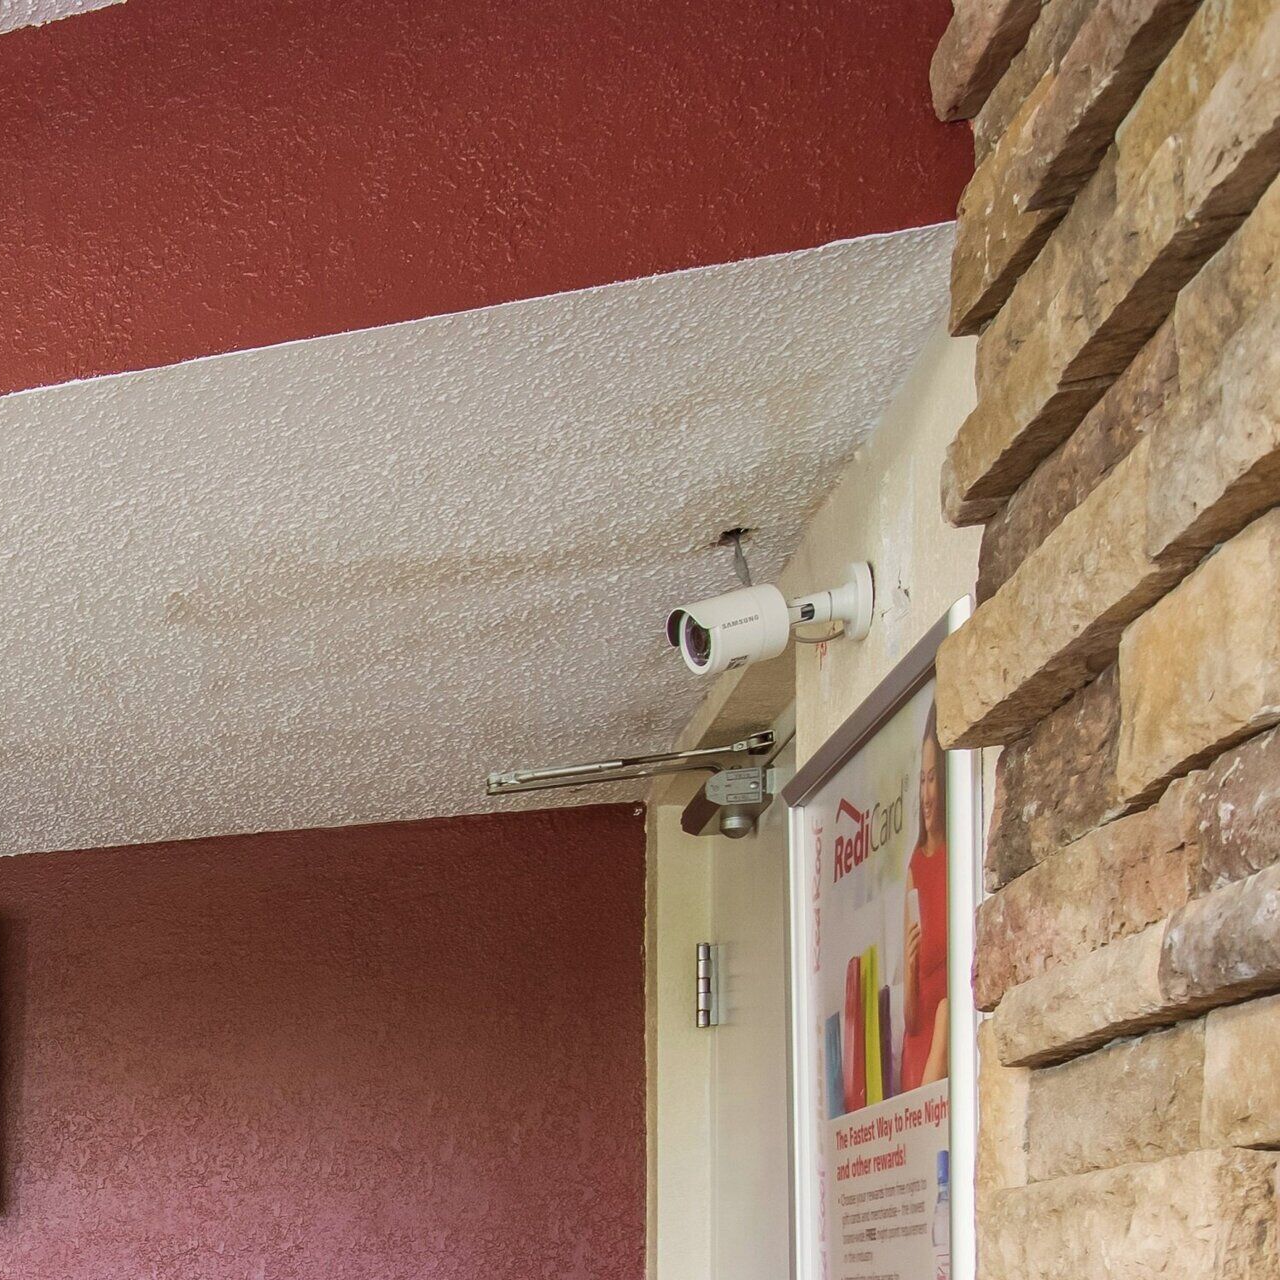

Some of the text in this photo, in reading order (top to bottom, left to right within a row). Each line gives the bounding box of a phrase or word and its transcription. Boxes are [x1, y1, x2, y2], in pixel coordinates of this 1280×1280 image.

[721, 614, 760, 630] SAMSUNG
[836, 1130, 848, 1151] The
[849, 1120, 875, 1147] Fastest
[876, 1115, 893, 1141] Way
[894, 1111, 904, 1133] to
[904, 1106, 922, 1130] Free
[836, 1144, 906, 1181] and other rewards!
